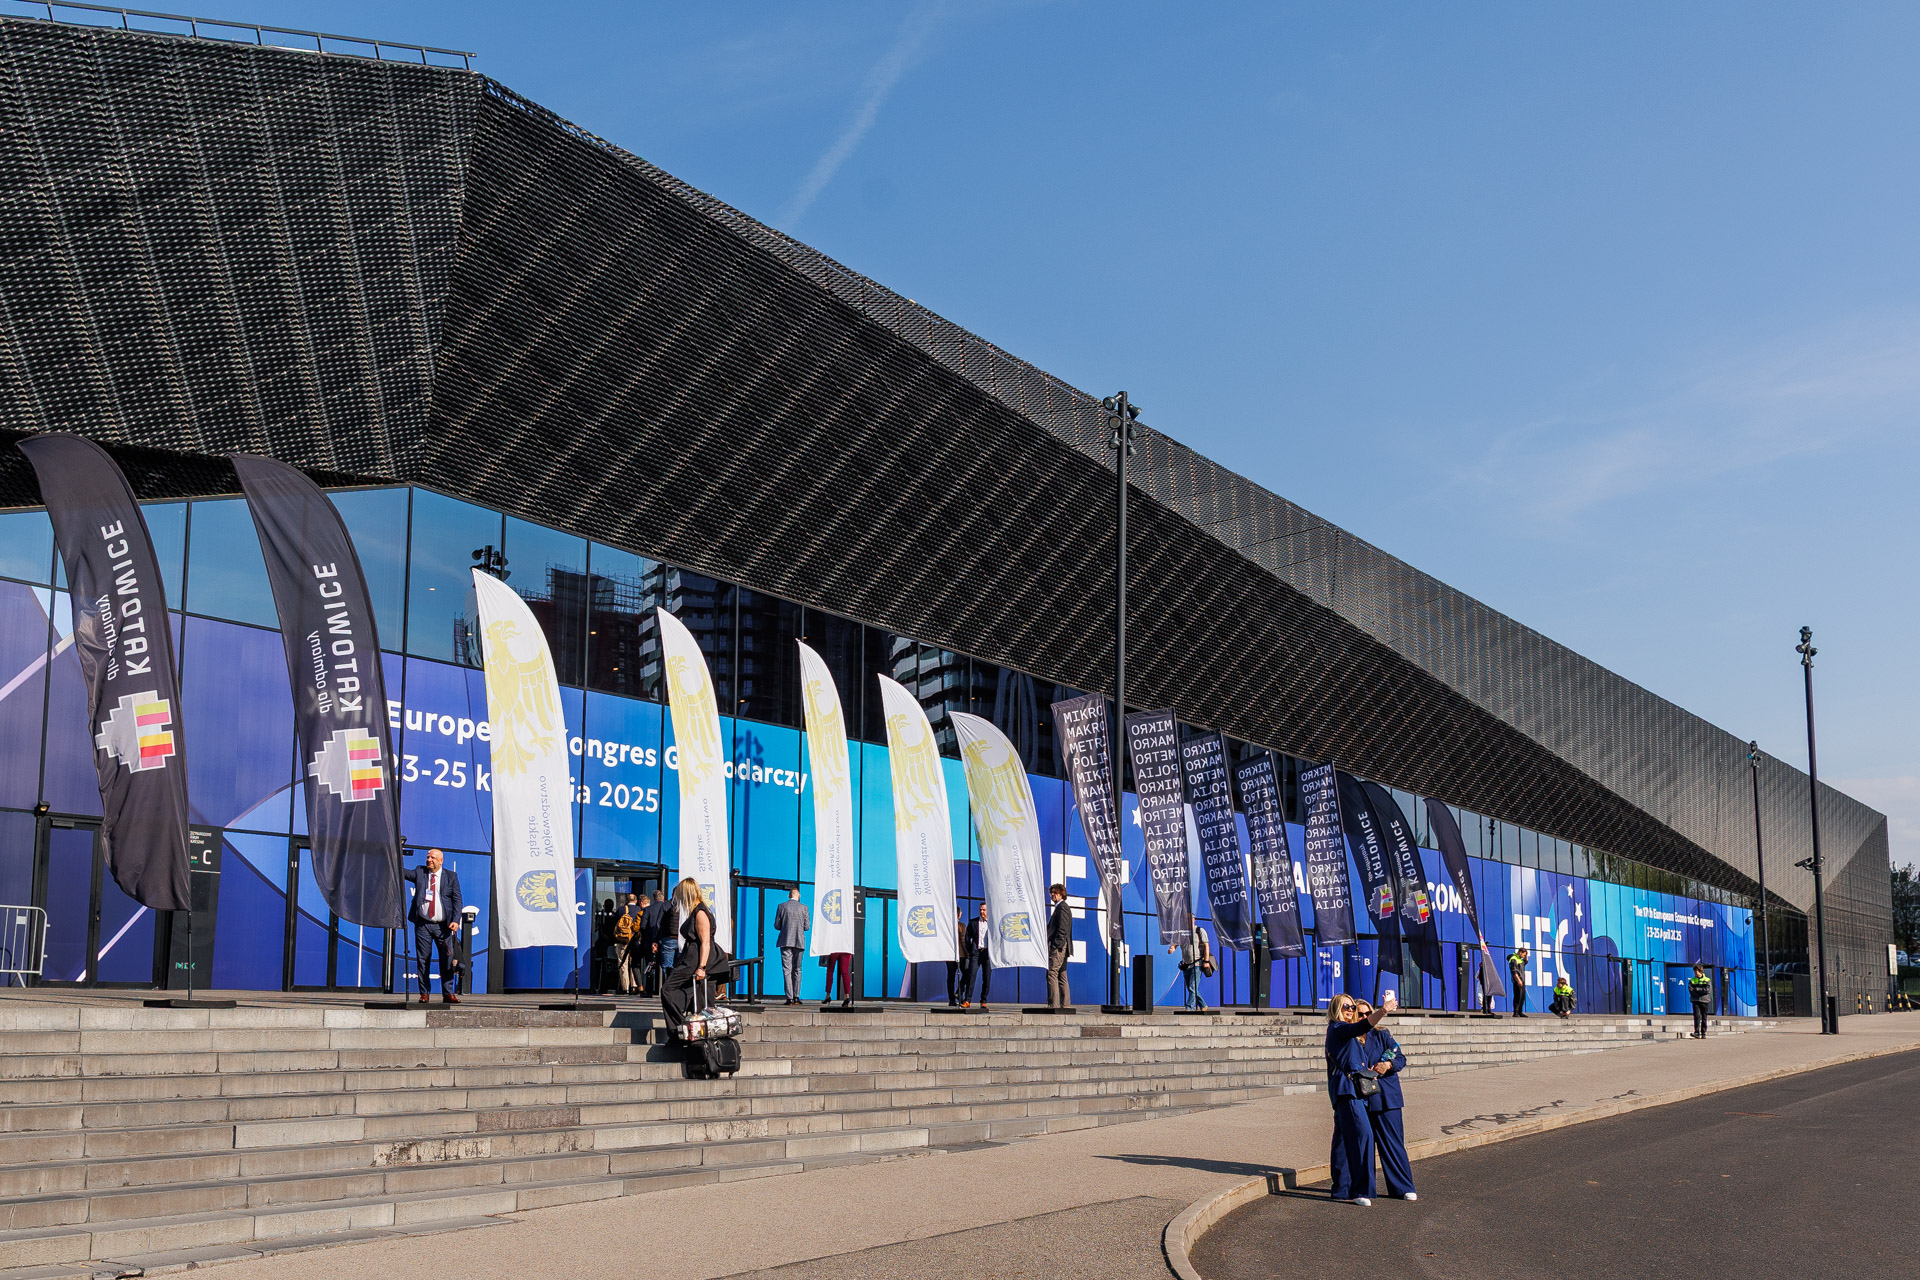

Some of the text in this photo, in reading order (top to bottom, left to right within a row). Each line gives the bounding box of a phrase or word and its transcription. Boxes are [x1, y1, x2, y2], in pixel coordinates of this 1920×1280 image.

[1063, 705, 1103, 723] MIKRO
[387, 699, 491, 745] Europe
[567, 731, 657, 768] ongres
[664, 745, 808, 795] Godarczy
[599, 781, 659, 813] 2025
[1088, 811, 1116, 827] POLI
[203, 849, 212, 865] C
[1513, 913, 1571, 988] EEC
[1334, 961, 1341, 978] B
[1364, 958, 1371, 966] B
